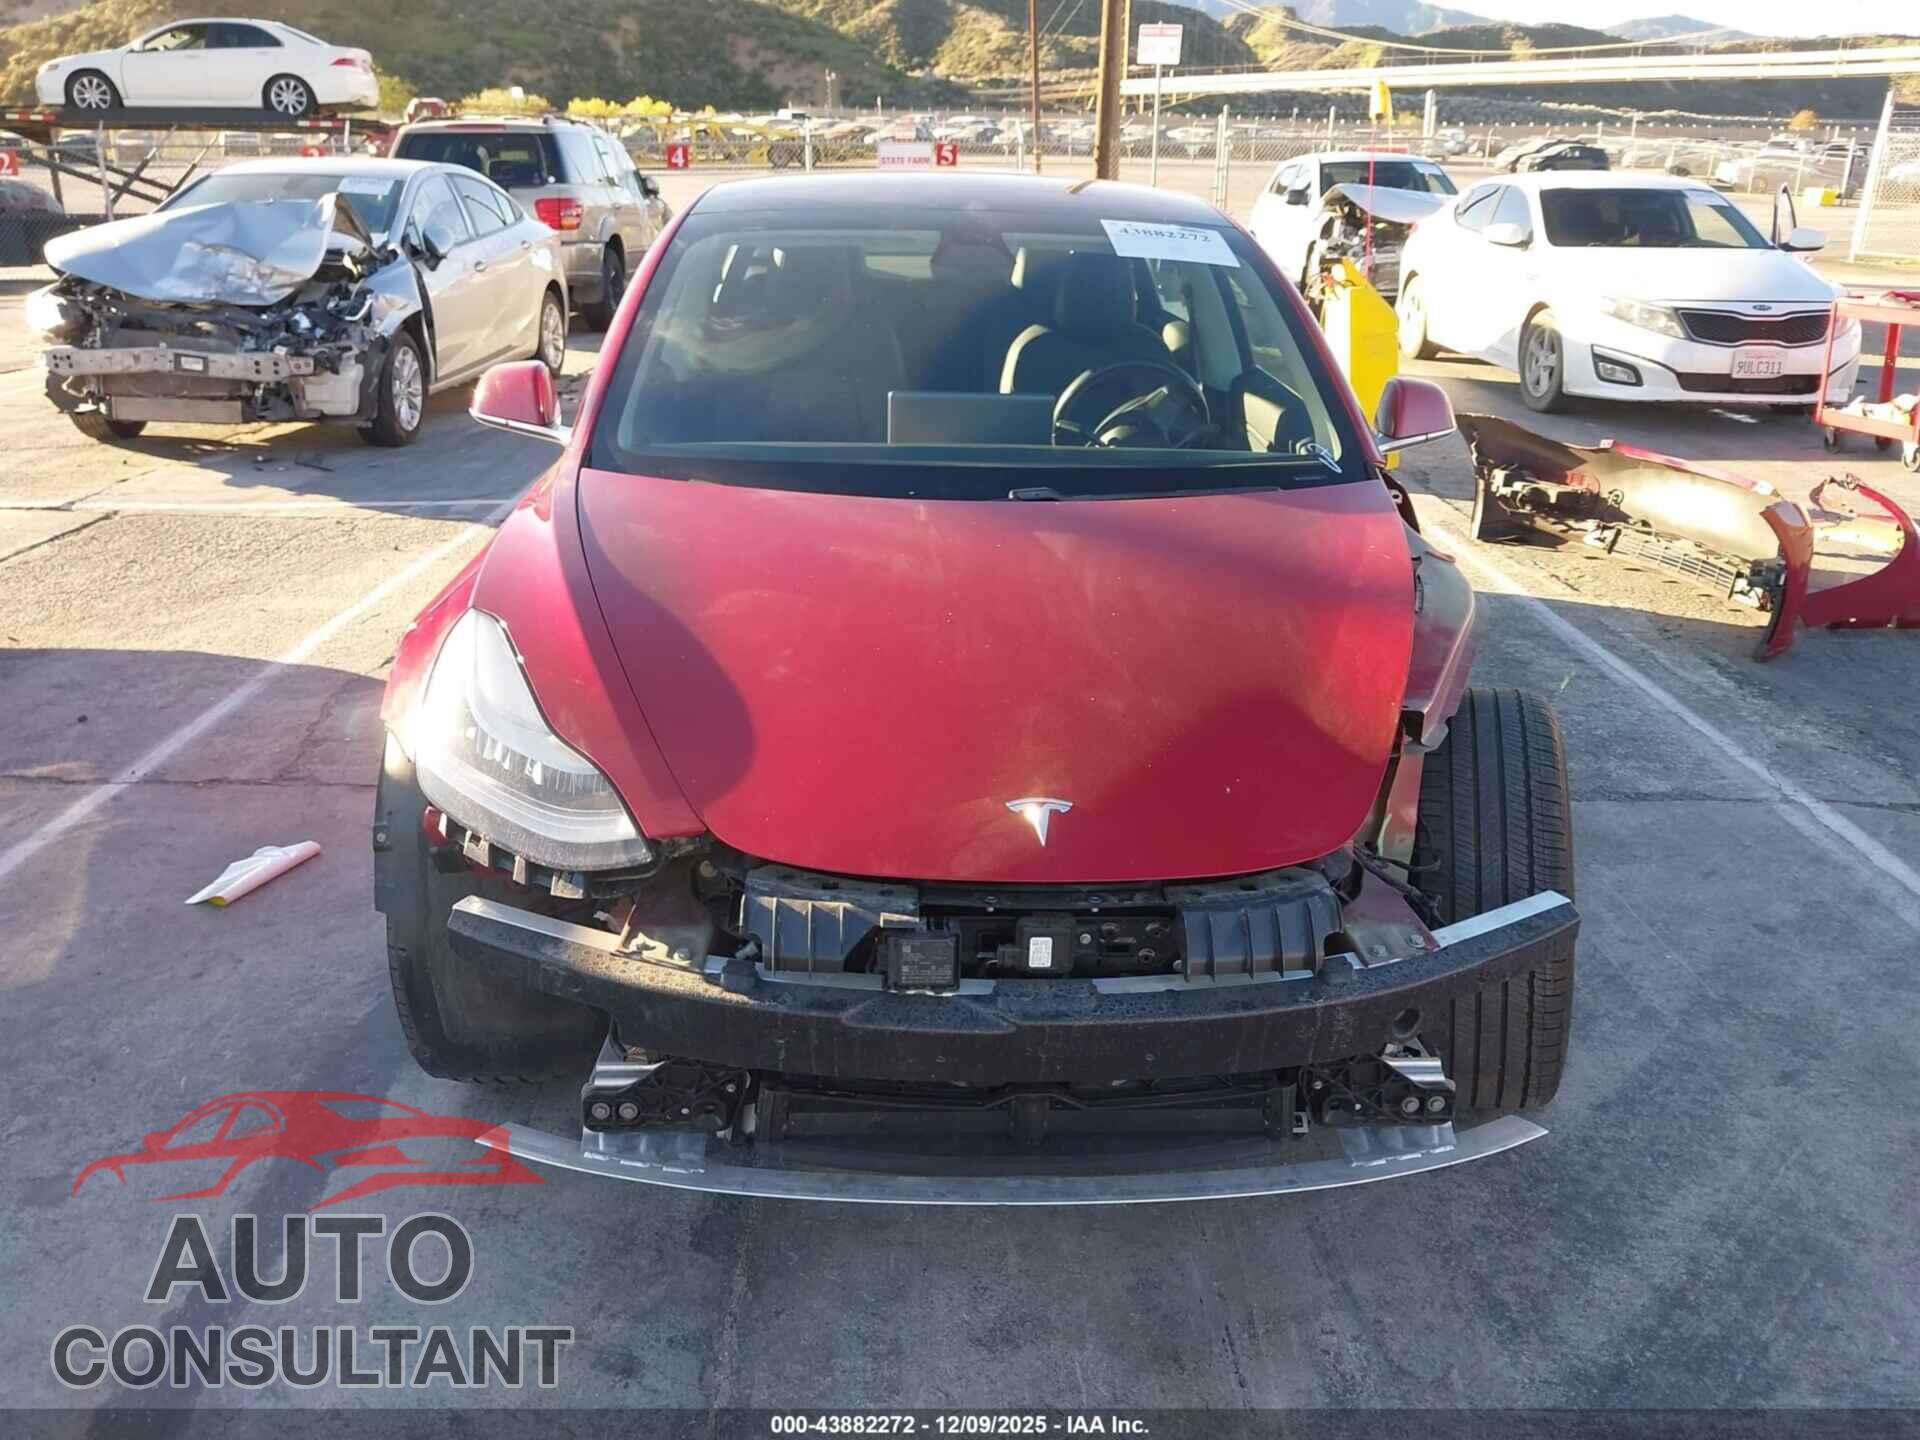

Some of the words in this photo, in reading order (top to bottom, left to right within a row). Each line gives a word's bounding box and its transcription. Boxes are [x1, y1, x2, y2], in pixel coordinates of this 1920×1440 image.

[671, 146, 685, 168] 4
[881, 156, 905, 165] STATE
[907, 156, 930, 165] FARM
[940, 144, 955, 167] 5
